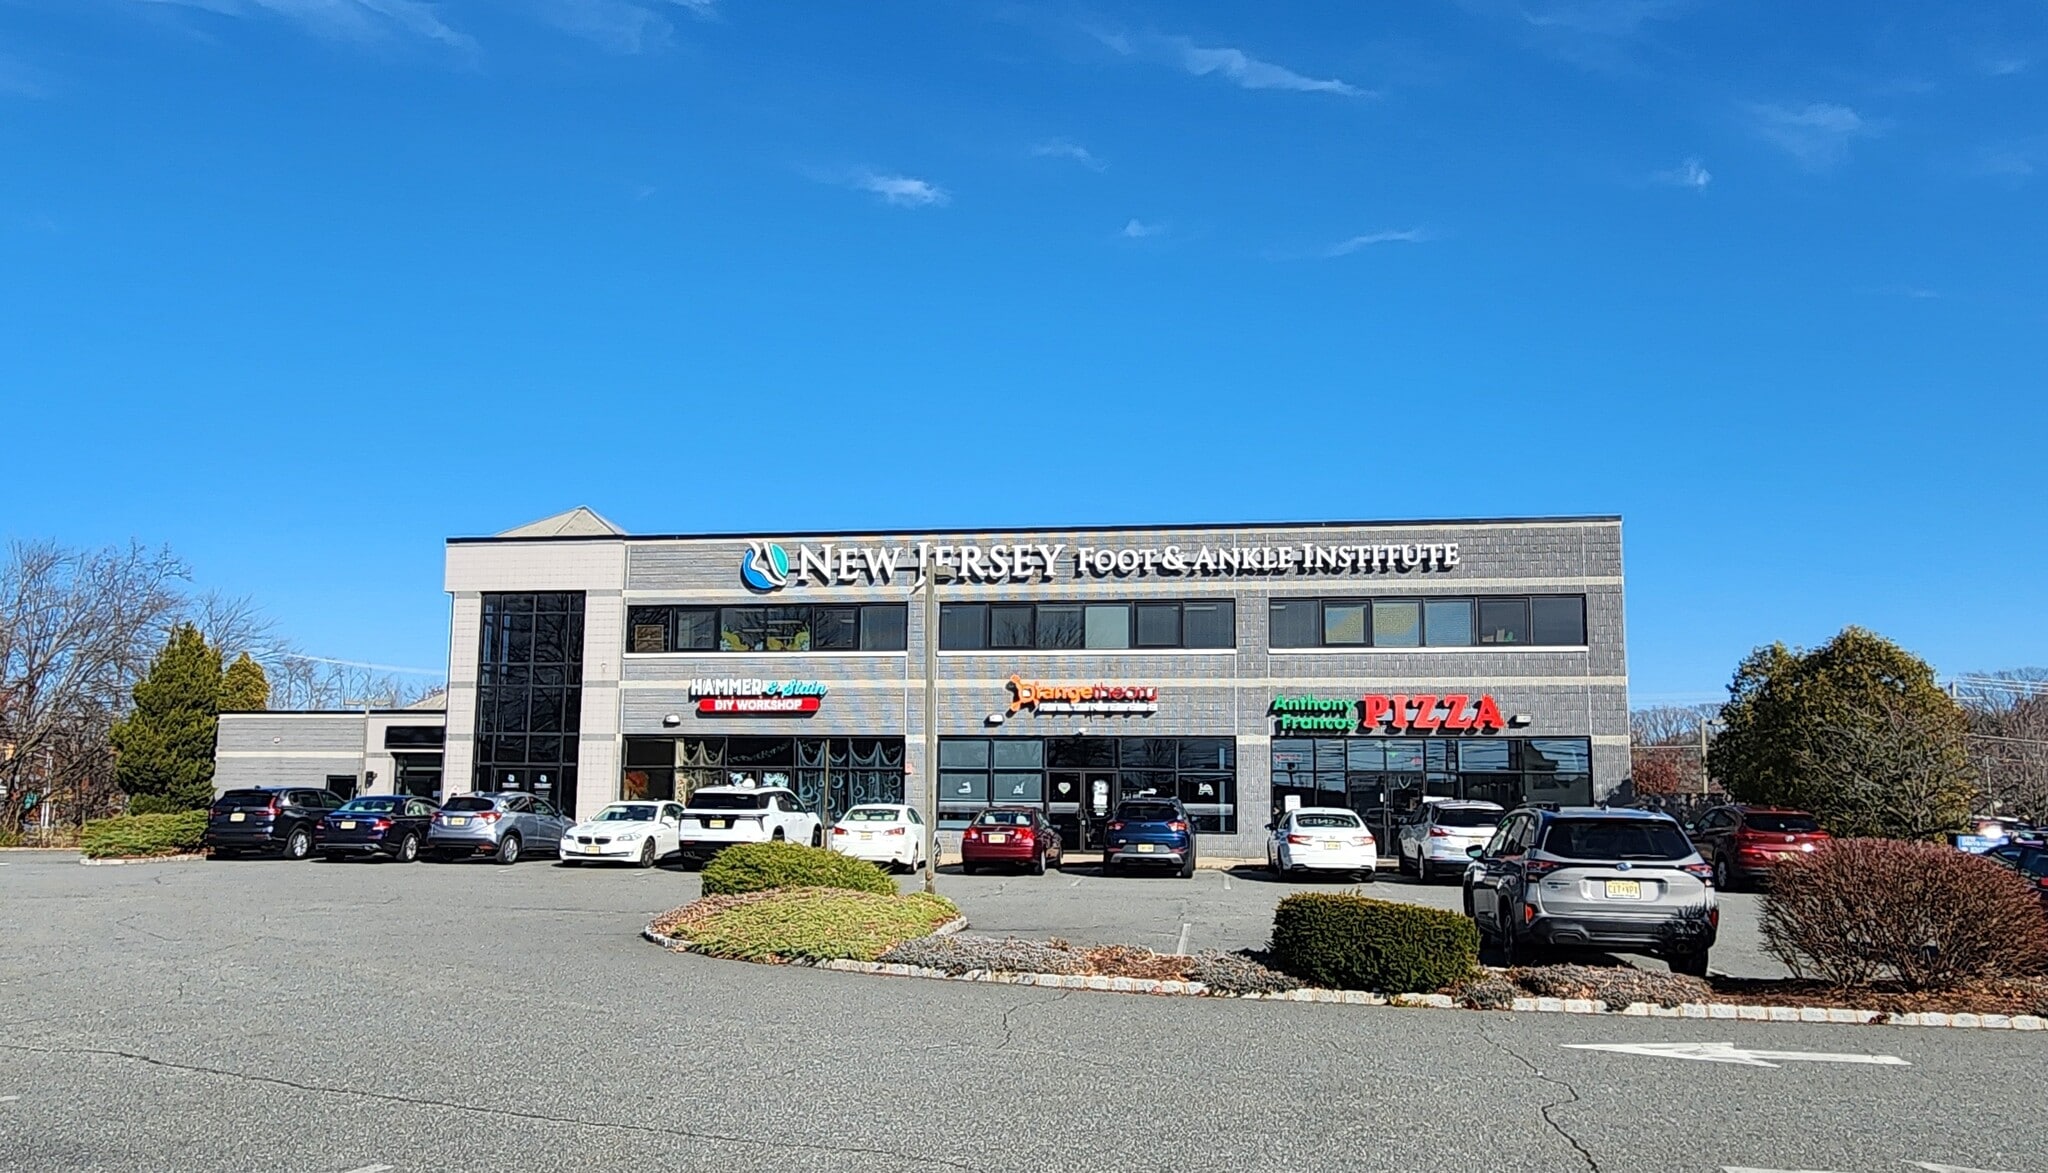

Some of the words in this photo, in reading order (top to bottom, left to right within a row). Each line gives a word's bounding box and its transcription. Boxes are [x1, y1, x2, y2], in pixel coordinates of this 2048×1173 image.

[797, 543, 904, 580] NEW
[914, 541, 1067, 588] JERSEY
[1077, 546, 1158, 572] FOOT
[1161, 545, 1191, 570] &
[1192, 545, 1294, 570] ANKLE
[1302, 542, 1461, 568] INSTITUTE
[690, 678, 763, 696] HAMMER
[766, 681, 780, 695] &
[781, 679, 827, 697] Stain
[714, 698, 735, 711] DIY
[736, 698, 803, 711] WORKSHOP
[1272, 692, 1355, 713] Anthony
[1363, 693, 1505, 729] PIZZA
